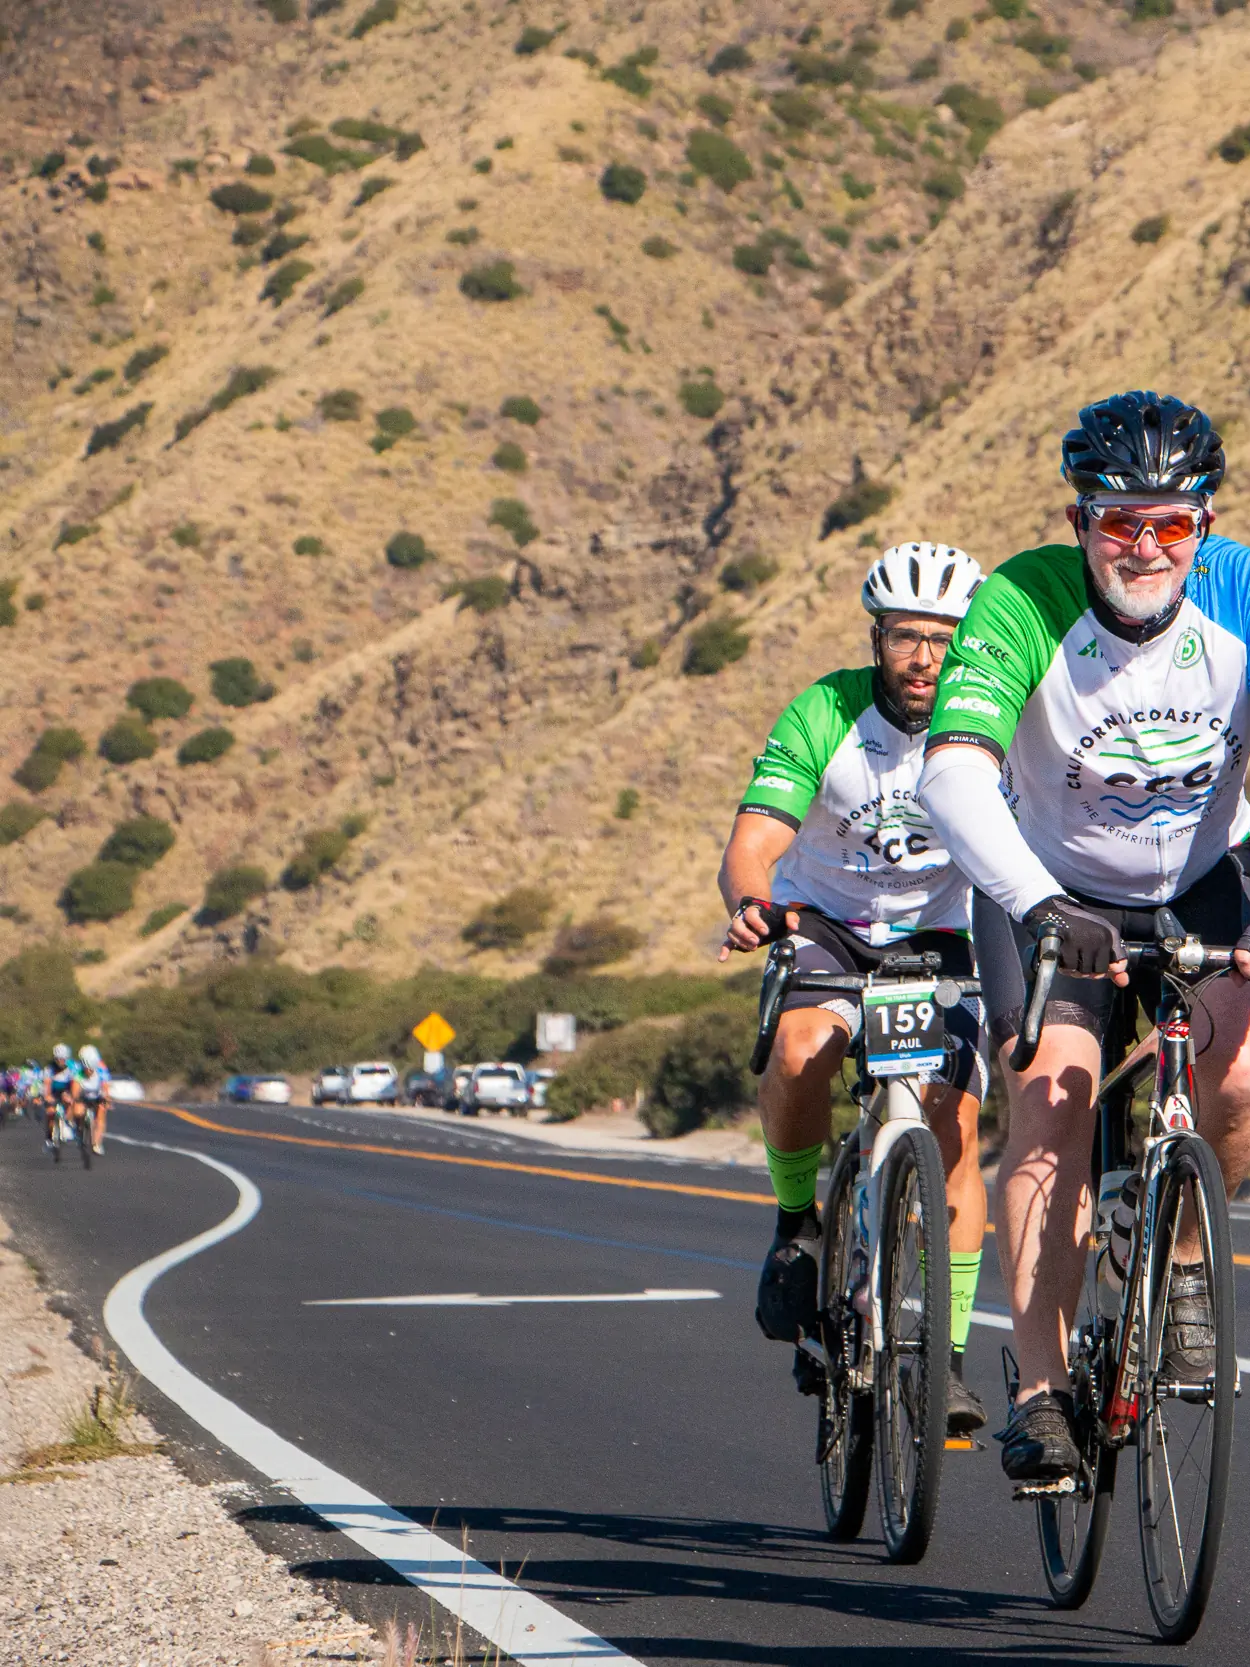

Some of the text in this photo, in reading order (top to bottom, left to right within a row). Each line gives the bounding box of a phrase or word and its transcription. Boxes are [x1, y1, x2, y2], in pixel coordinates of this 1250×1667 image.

[948, 735, 979, 745] PRIMAL
[1067, 712, 1133, 790] CALIFORNI
[1133, 707, 1203, 724] COAST
[1208, 717, 1243, 771] CASSIC
[1080, 799, 1100, 821] THE
[1099, 821, 1162, 847] ARTHRITIS
[840, 848, 851, 864] THE
[887, 867, 947, 889] FOUNDATIO
[876, 1001, 935, 1035] 159
[891, 1037, 923, 1051] PAUL
